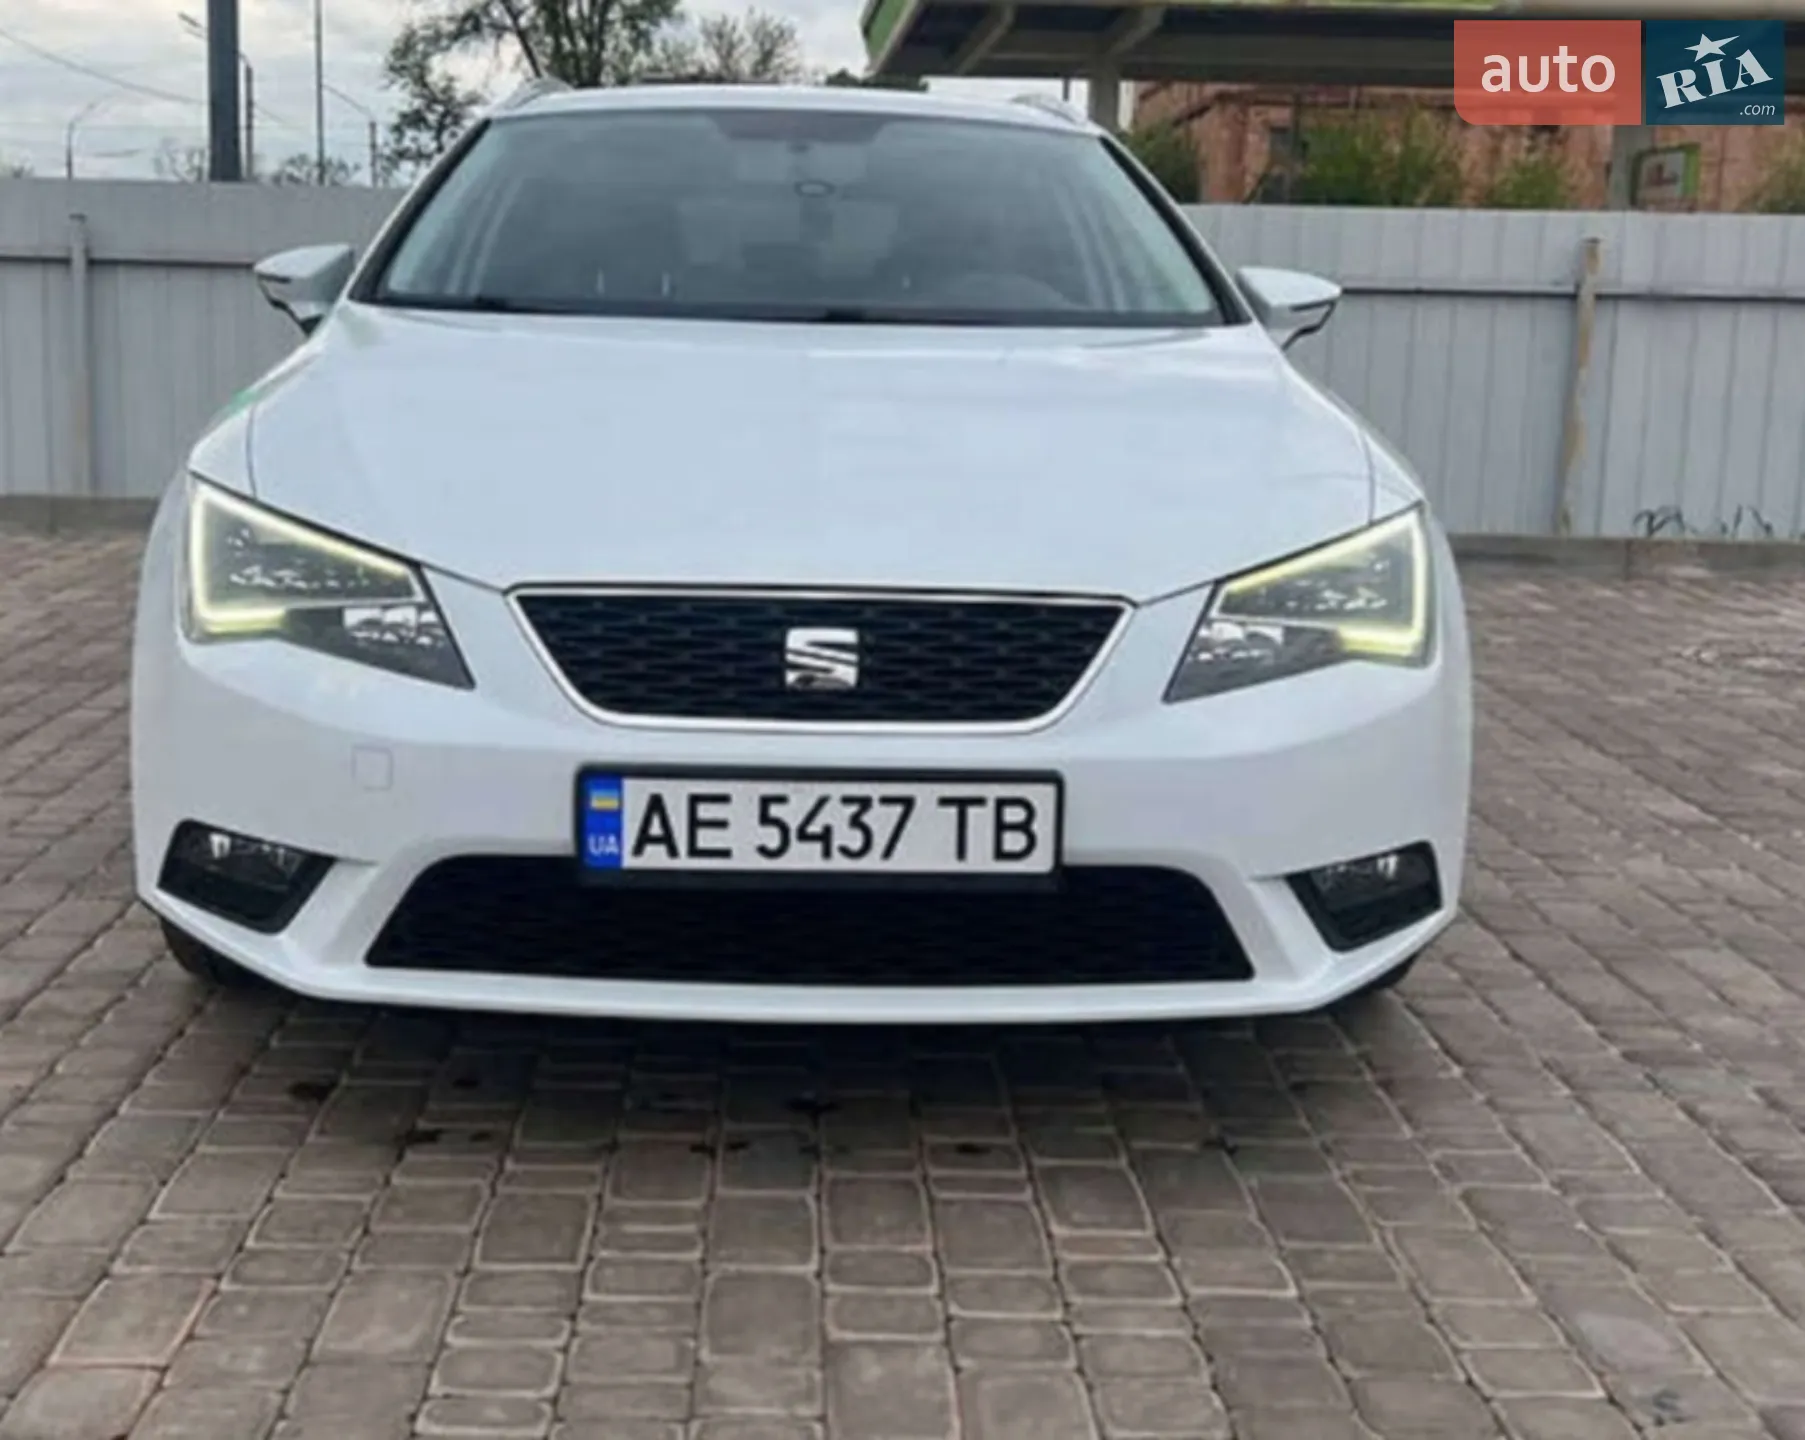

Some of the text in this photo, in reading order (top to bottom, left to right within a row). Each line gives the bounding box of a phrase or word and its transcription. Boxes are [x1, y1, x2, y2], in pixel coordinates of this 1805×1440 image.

[588, 833, 620, 856] UA
[632, 793, 1037, 862] AE 5437 TB
